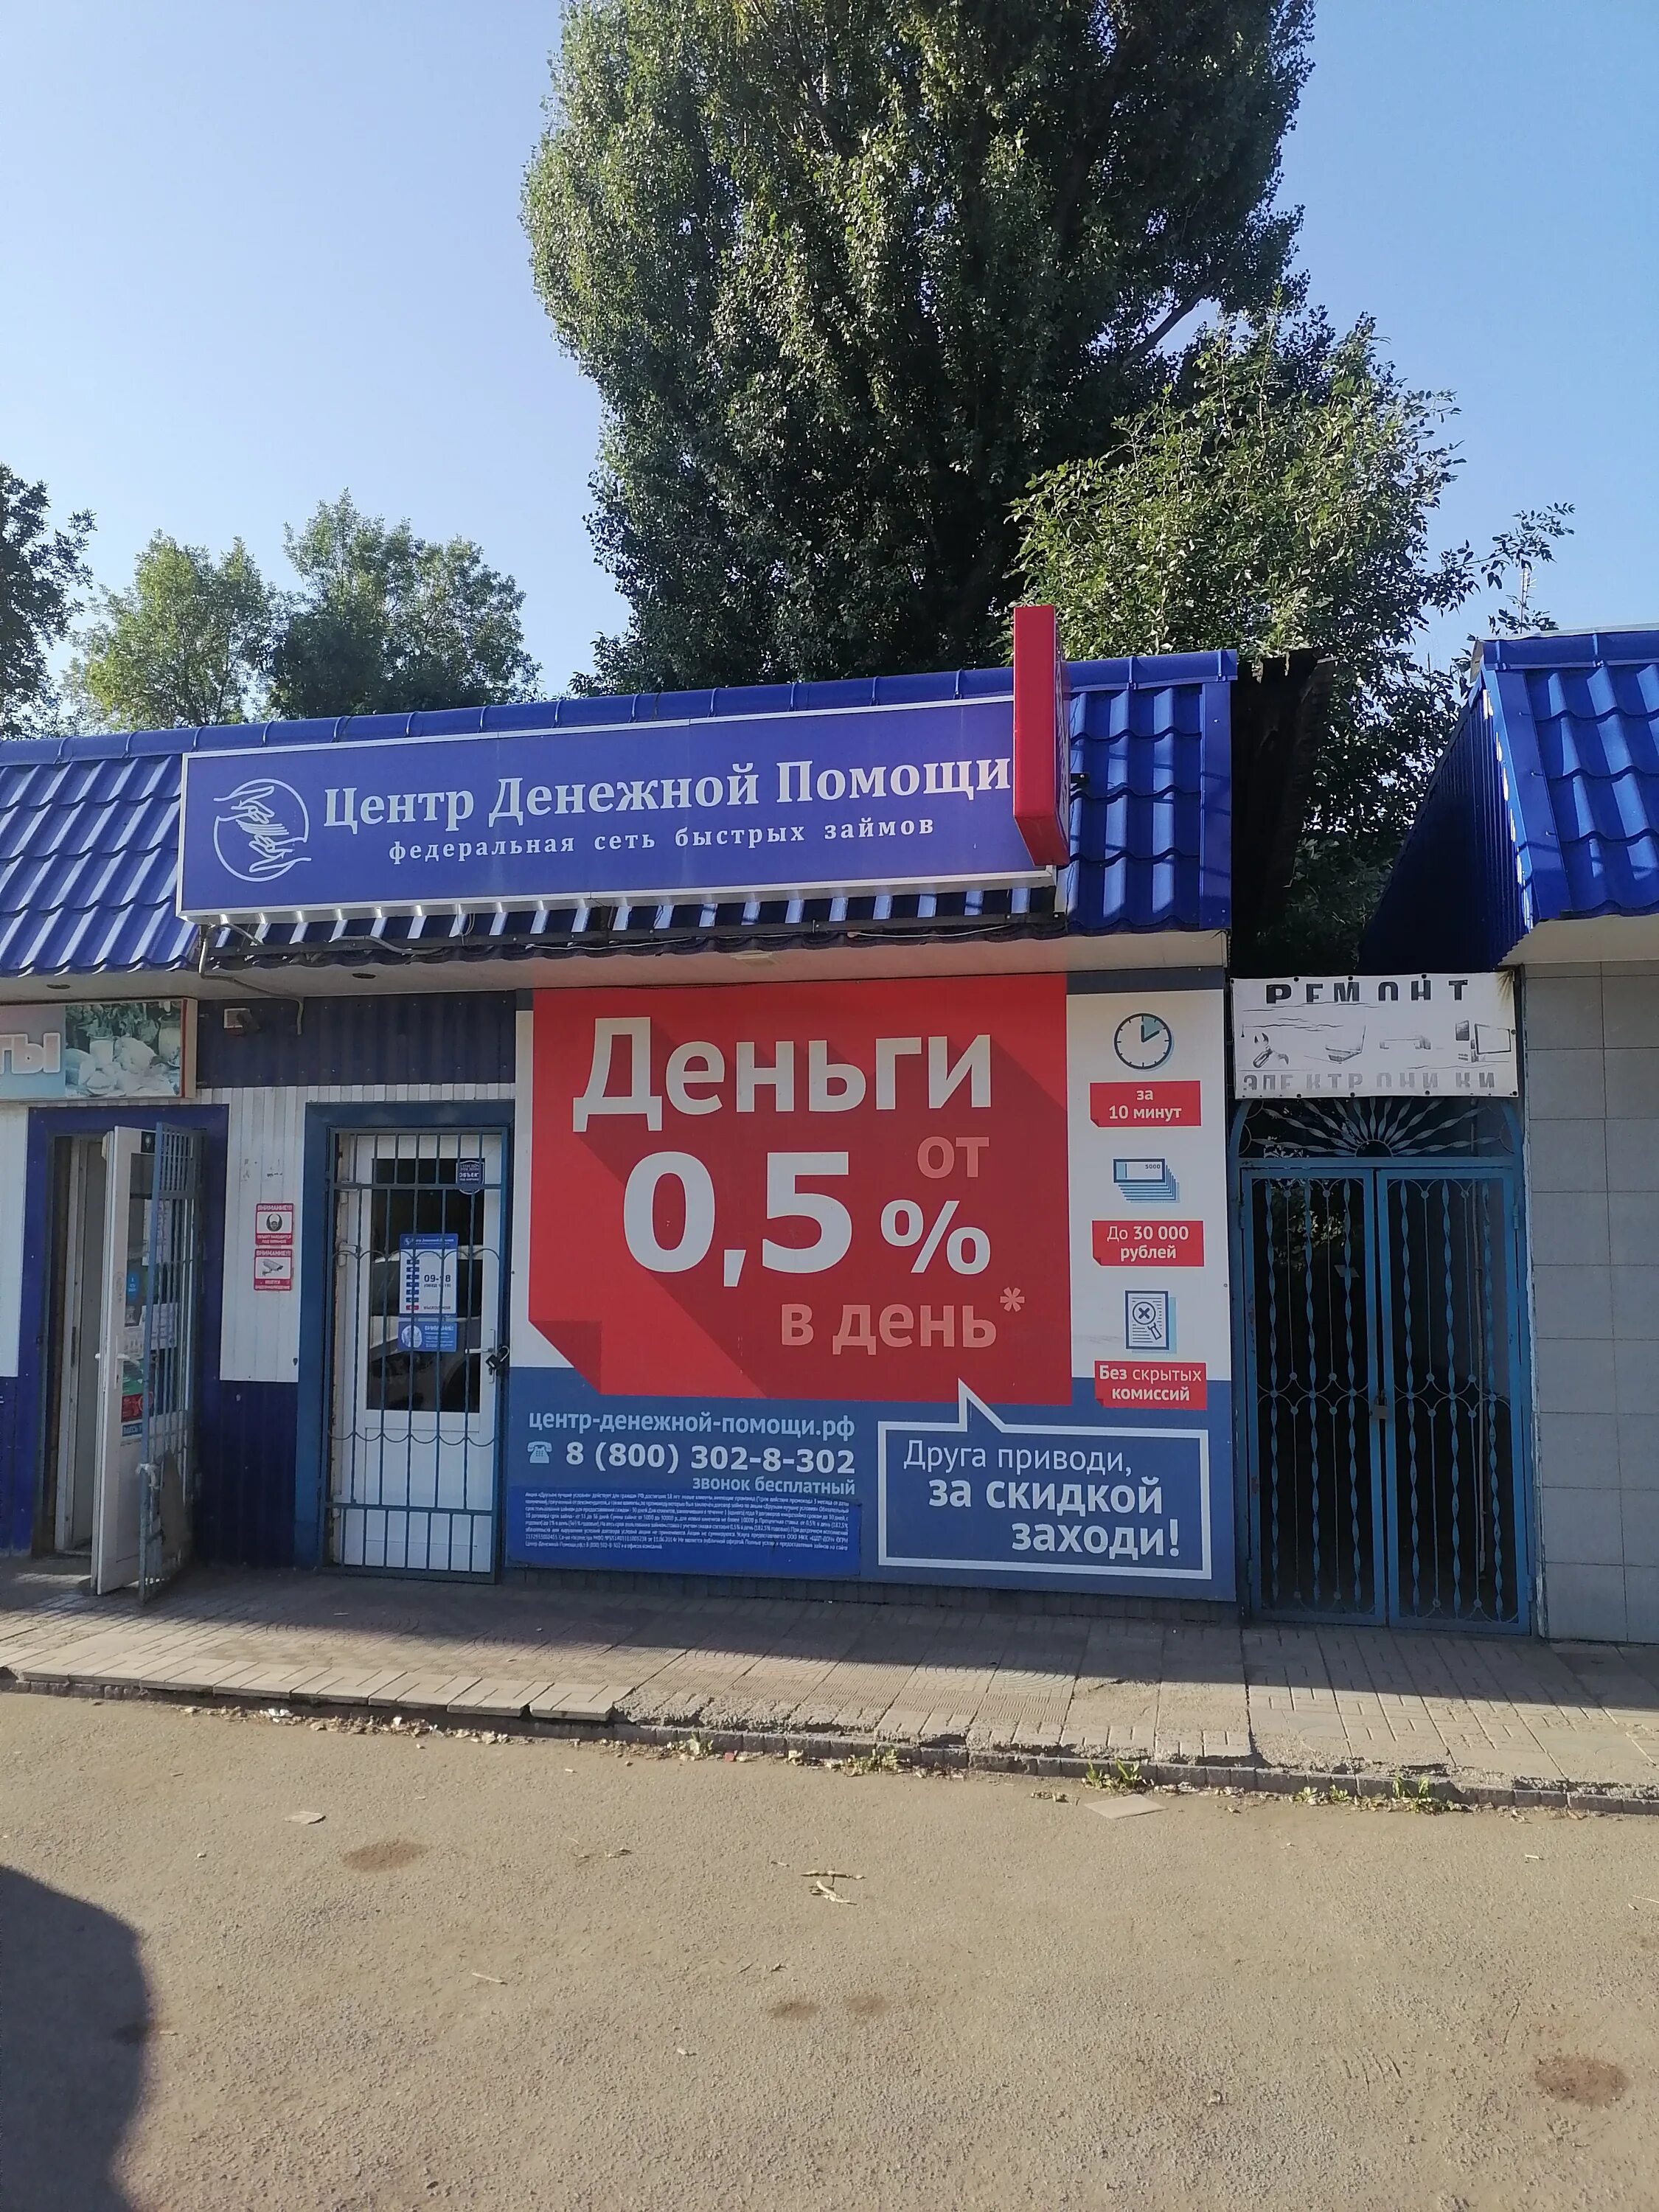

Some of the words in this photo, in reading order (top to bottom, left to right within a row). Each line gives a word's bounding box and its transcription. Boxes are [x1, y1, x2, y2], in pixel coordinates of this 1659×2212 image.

[323, 787, 474, 835] Центр
[488, 762, 759, 827] Денежной
[776, 757, 1012, 802] Помощи
[389, 837, 575, 865] федеральная
[594, 831, 655, 850] сеть
[675, 824, 805, 849] быстрых
[824, 817, 934, 840] займов
[573, 1016, 991, 1133] Деньги
[1109, 1105, 1130, 1120] 10
[1133, 1106, 1182, 1121] минут
[1136, 1089, 1154, 1102] за
[917, 1136, 990, 1178] от
[623, 1151, 852, 1287] 0,5
[880, 1199, 991, 1275] %
[1107, 1226, 1130, 1242] До
[1134, 1226, 1154, 1242] 30
[1157, 1226, 1189, 1241] 000
[1120, 1244, 1177, 1262] рублей
[781, 1304, 814, 1347] в
[1099, 1366, 1128, 1380] Без
[1133, 1368, 1203, 1385] скрытых
[1111, 1385, 1190, 1402] комиссий
[529, 1411, 855, 1441] центр-денежной-помощи.рф
[566, 1441, 584, 1466] 8
[595, 1441, 680, 1474] (800)
[691, 1445, 855, 1474] 302-8-302
[903, 1439, 987, 1473] Друга
[998, 1447, 1132, 1477] приводи,
[692, 1476, 751, 1492] звонок
[755, 1475, 855, 1495] бесплатный
[928, 1478, 971, 1508] за
[986, 1475, 1163, 1517] скидкой
[1011, 1518, 1180, 1561] заходи!
